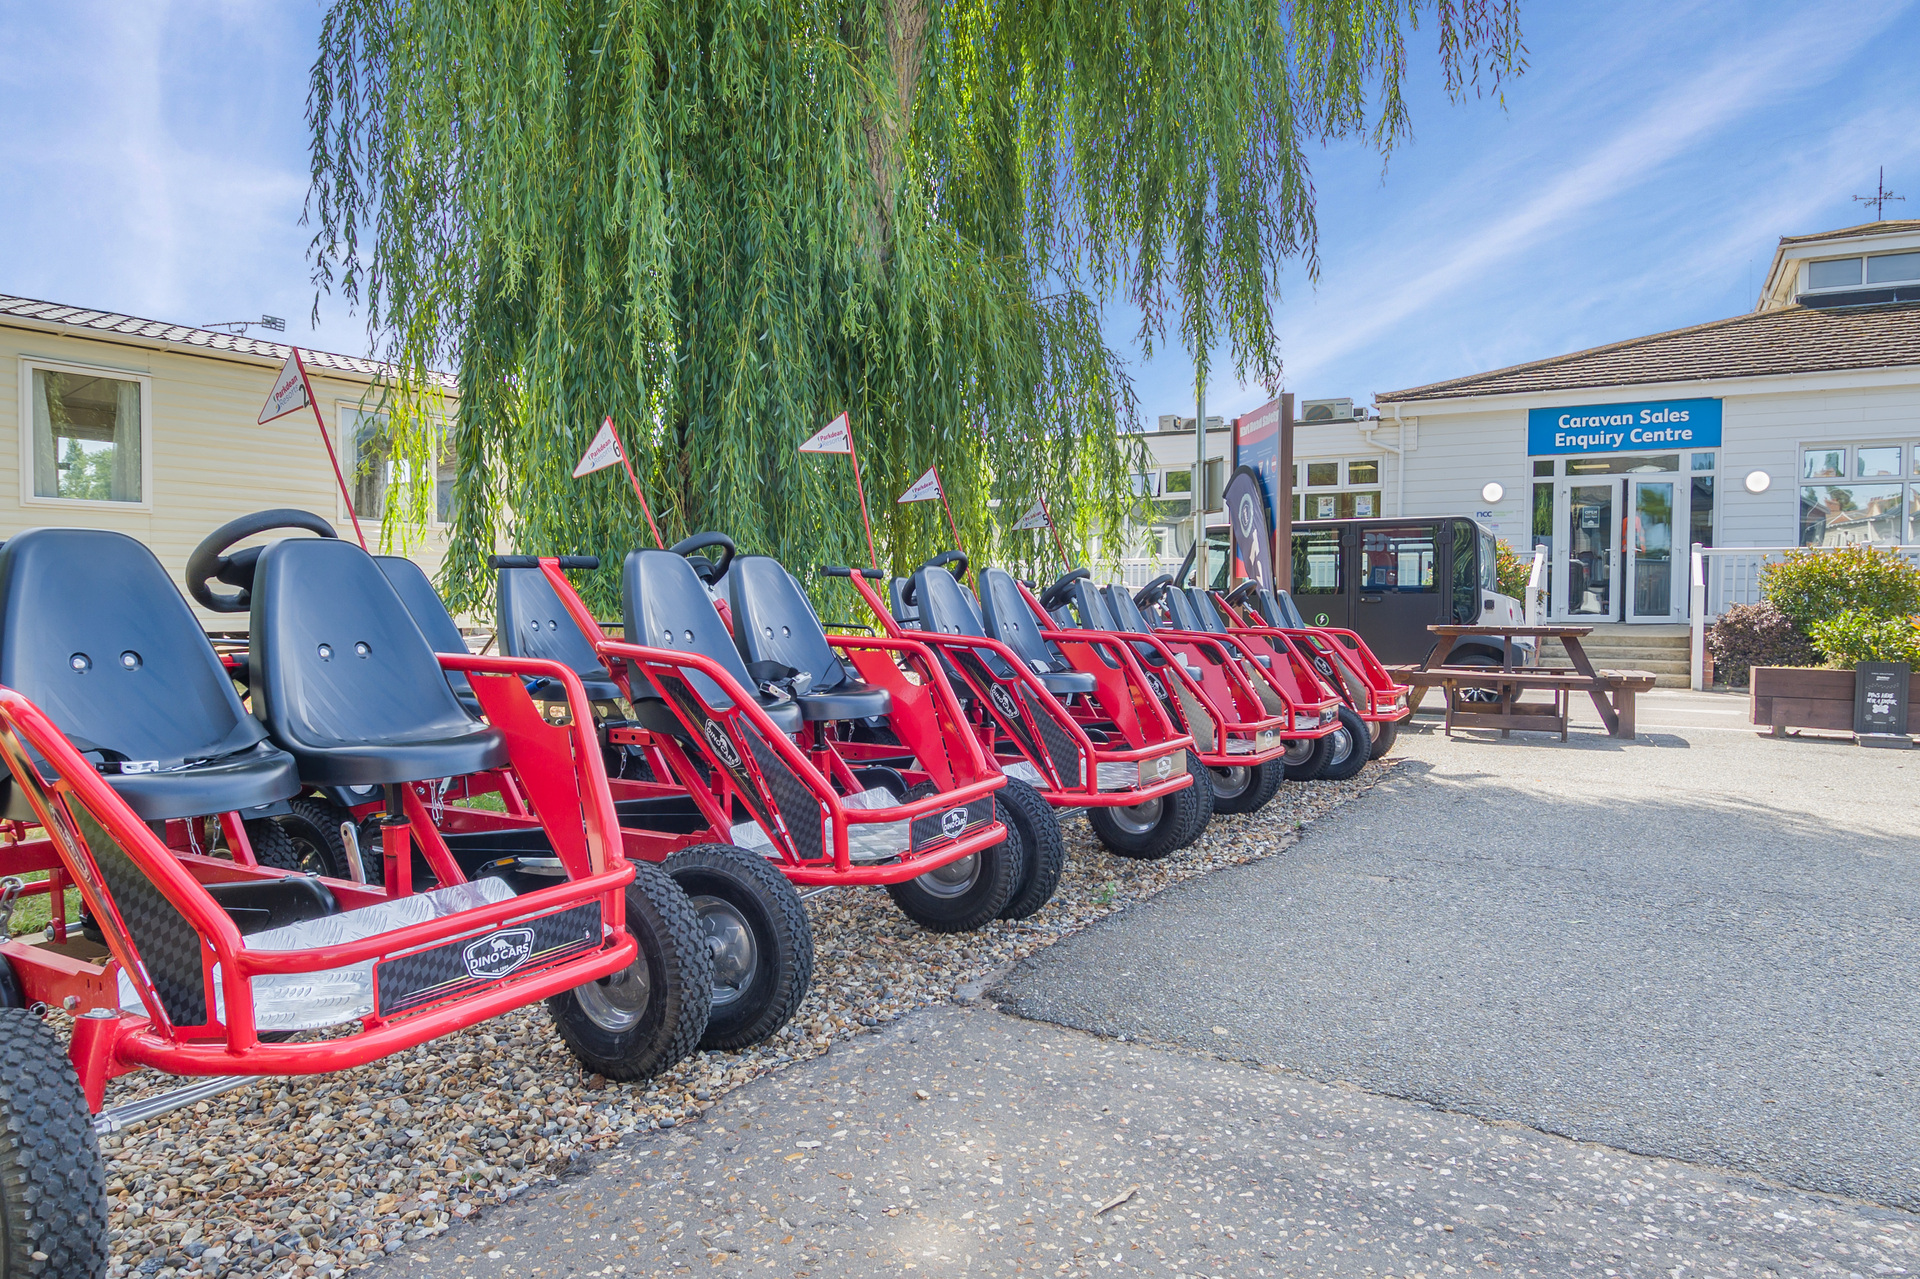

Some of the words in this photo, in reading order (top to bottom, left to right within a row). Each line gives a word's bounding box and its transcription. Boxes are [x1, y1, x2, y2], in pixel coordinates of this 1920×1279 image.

[275, 375, 298, 400] Parkdean
[298, 384, 310, 408] 2
[1558, 414, 1633, 429] Caravan
[1640, 408, 1690, 425] Sales
[820, 430, 844, 442] Parkdean
[842, 434, 849, 450] 1
[1555, 431, 1625, 449] Enquiry
[1630, 427, 1693, 443] Centre
[590, 439, 611, 459] Parkdean
[613, 440, 621, 458] 6
[1042, 514, 1050, 525] 5
[706, 727, 721, 746] DINO
[470, 952, 499, 970] DINO
[500, 943, 529, 960] CARS
